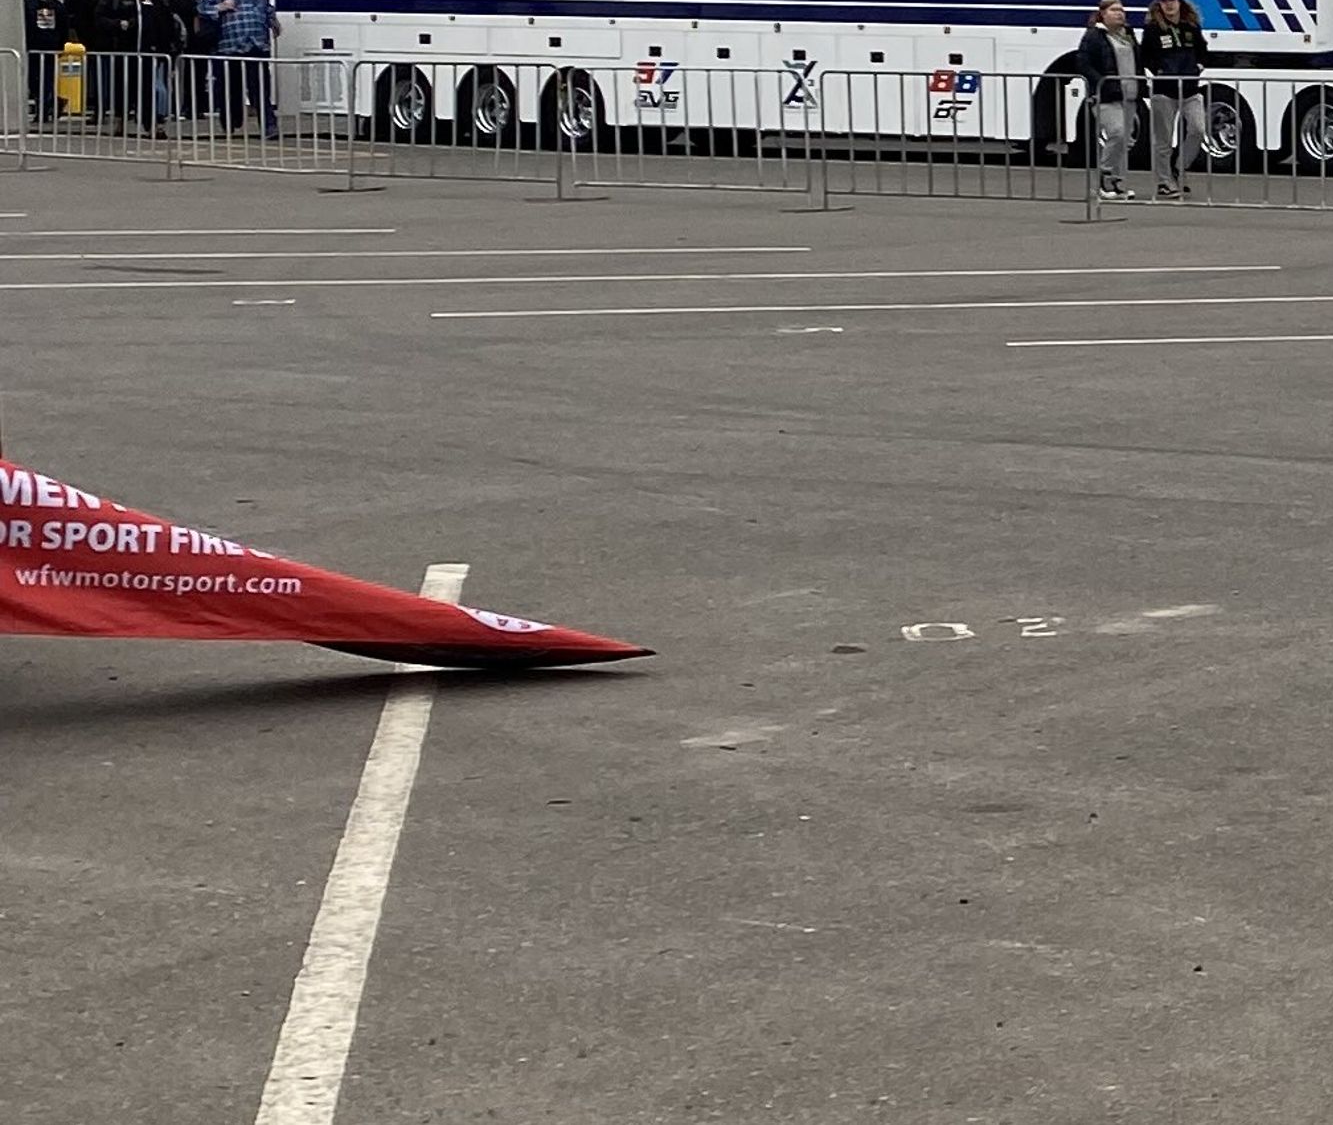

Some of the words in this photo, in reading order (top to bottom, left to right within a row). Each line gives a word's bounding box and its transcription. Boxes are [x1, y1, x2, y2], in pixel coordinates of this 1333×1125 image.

[0, 519, 32, 550] R
[40, 520, 164, 555] SPORT
[14, 562, 301, 595] wfwmotorsport.com
